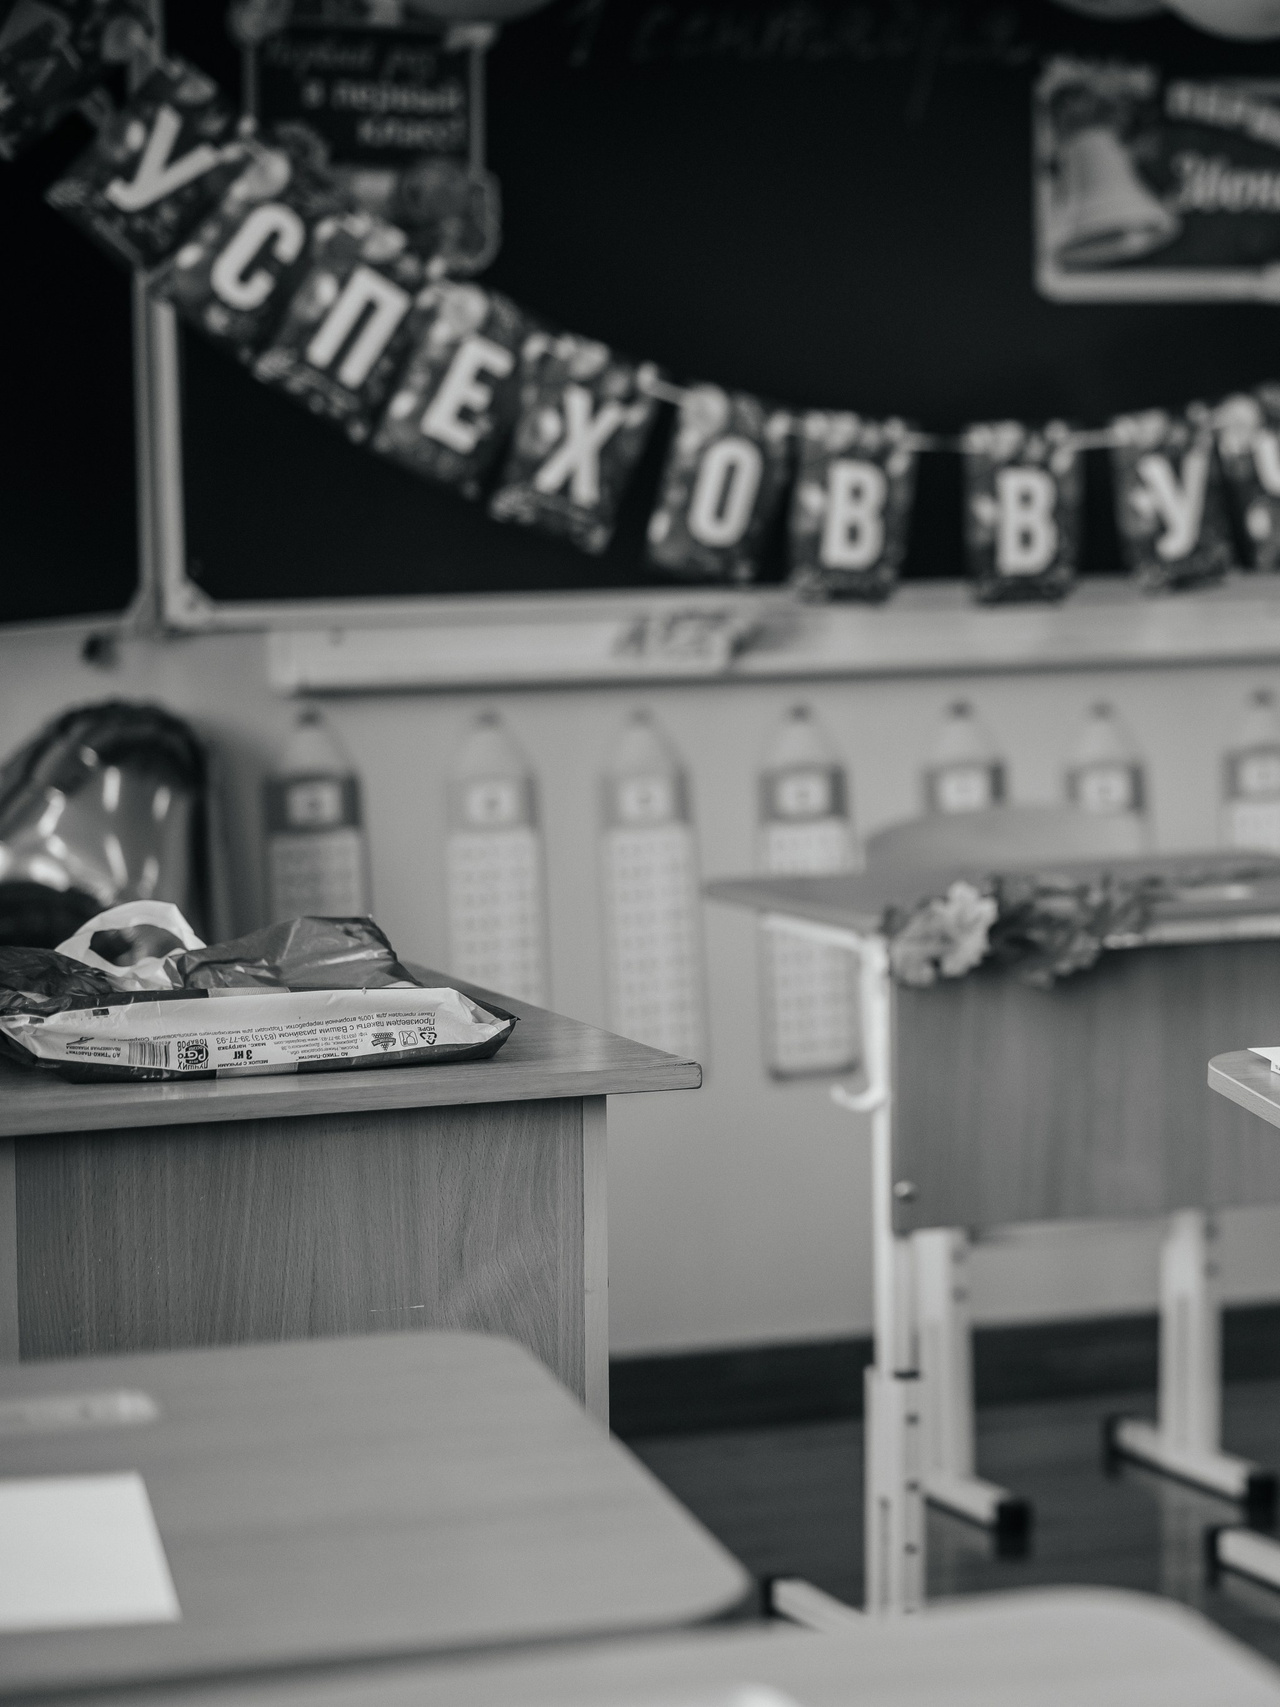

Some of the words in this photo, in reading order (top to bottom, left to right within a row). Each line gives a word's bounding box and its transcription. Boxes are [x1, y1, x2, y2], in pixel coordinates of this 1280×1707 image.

[104, 105, 887, 570] УСПЕХОВ
[997, 466, 1058, 575] В
[324, 1016, 357, 1025] вторичной
[358, 1014, 374, 1022] 100%
[385, 1017, 435, 1027] Произведем
[284, 1019, 324, 1029] переработки.
[356, 1020, 384, 1030] пакеты
[278, 1028, 317, 1038] дизайном
[318, 1025, 348, 1034] Вашим
[215, 1035, 250, 1044] 39-77-93
[251, 1032, 277, 1042] (8313)
[177, 1038, 208, 1052] ТОВАРОВ
[246, 1049, 252, 1060] 3
[177, 1059, 209, 1070] ЛУЧШИХ
